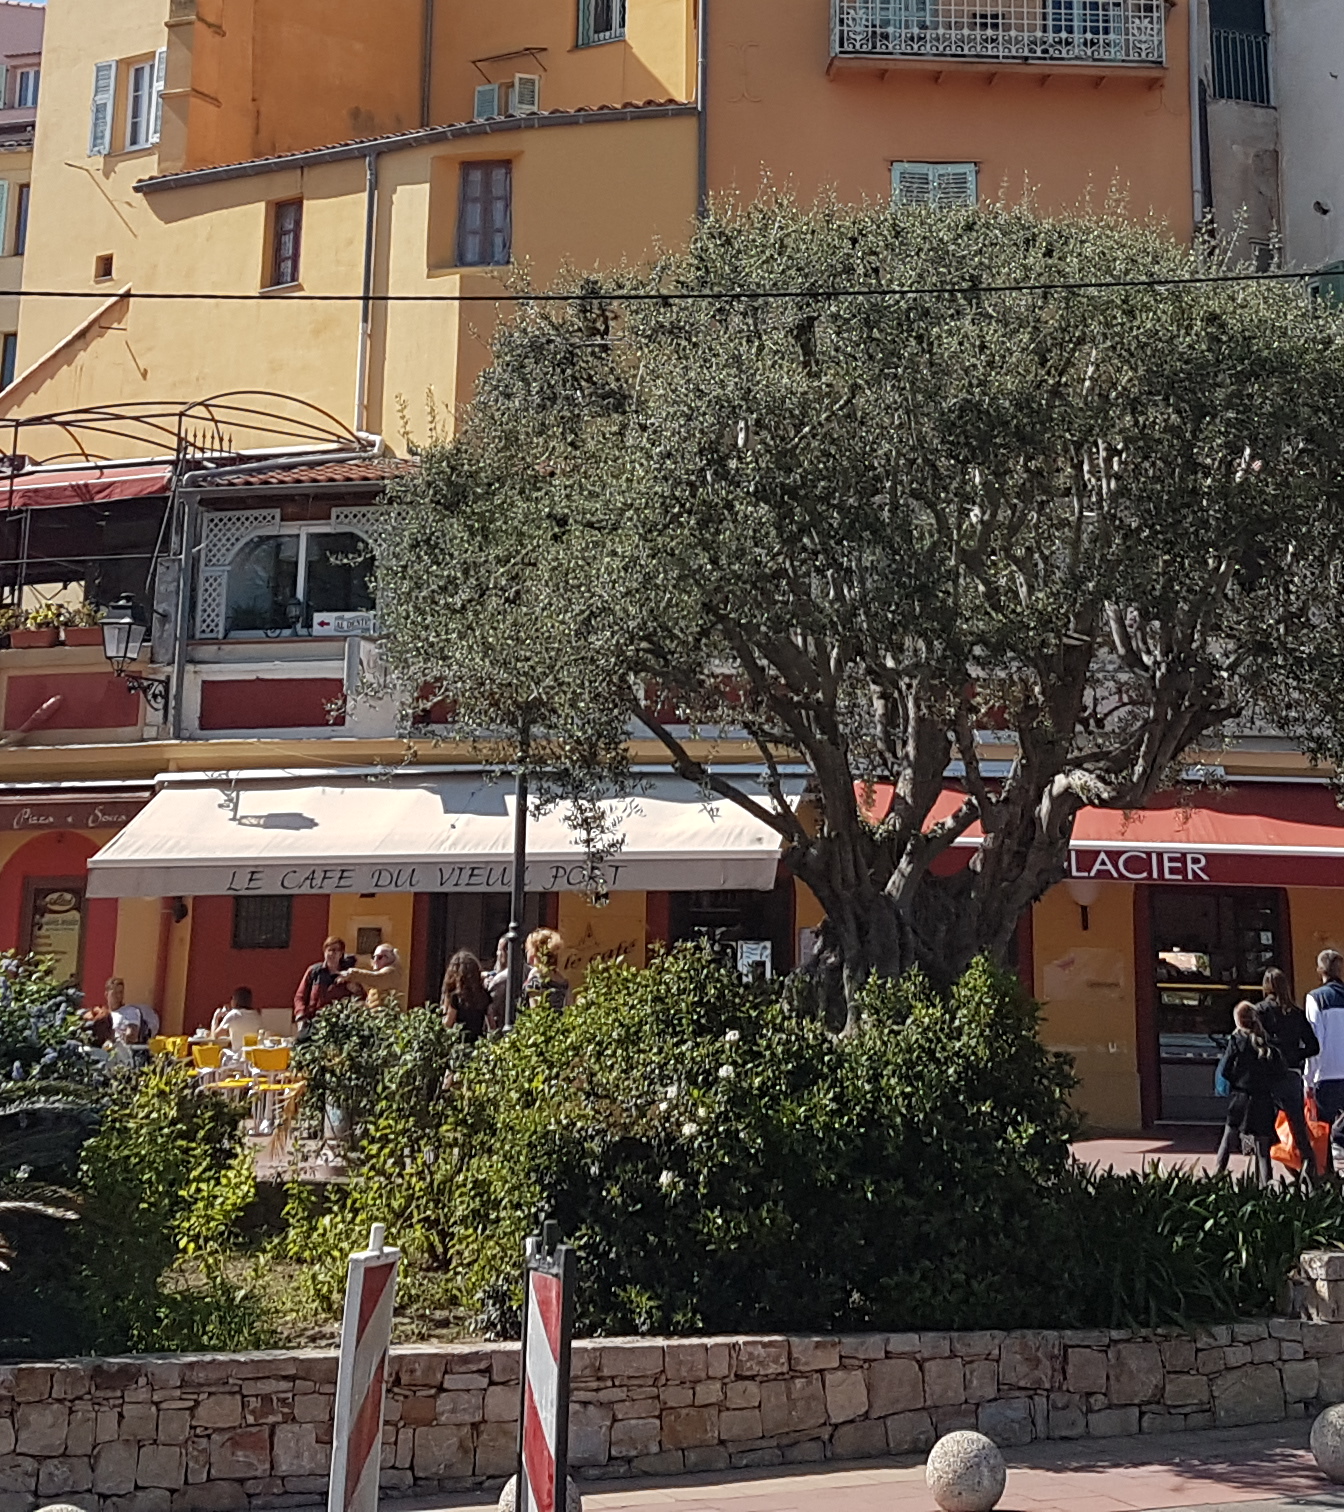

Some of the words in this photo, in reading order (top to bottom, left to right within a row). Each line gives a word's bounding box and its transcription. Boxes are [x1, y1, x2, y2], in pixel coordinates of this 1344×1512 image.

[225, 870, 265, 892] LE
[280, 868, 356, 890] CAFE
[371, 867, 421, 889] DU
[438, 865, 532, 888] VIEU
[1063, 850, 1211, 881] LACIER
